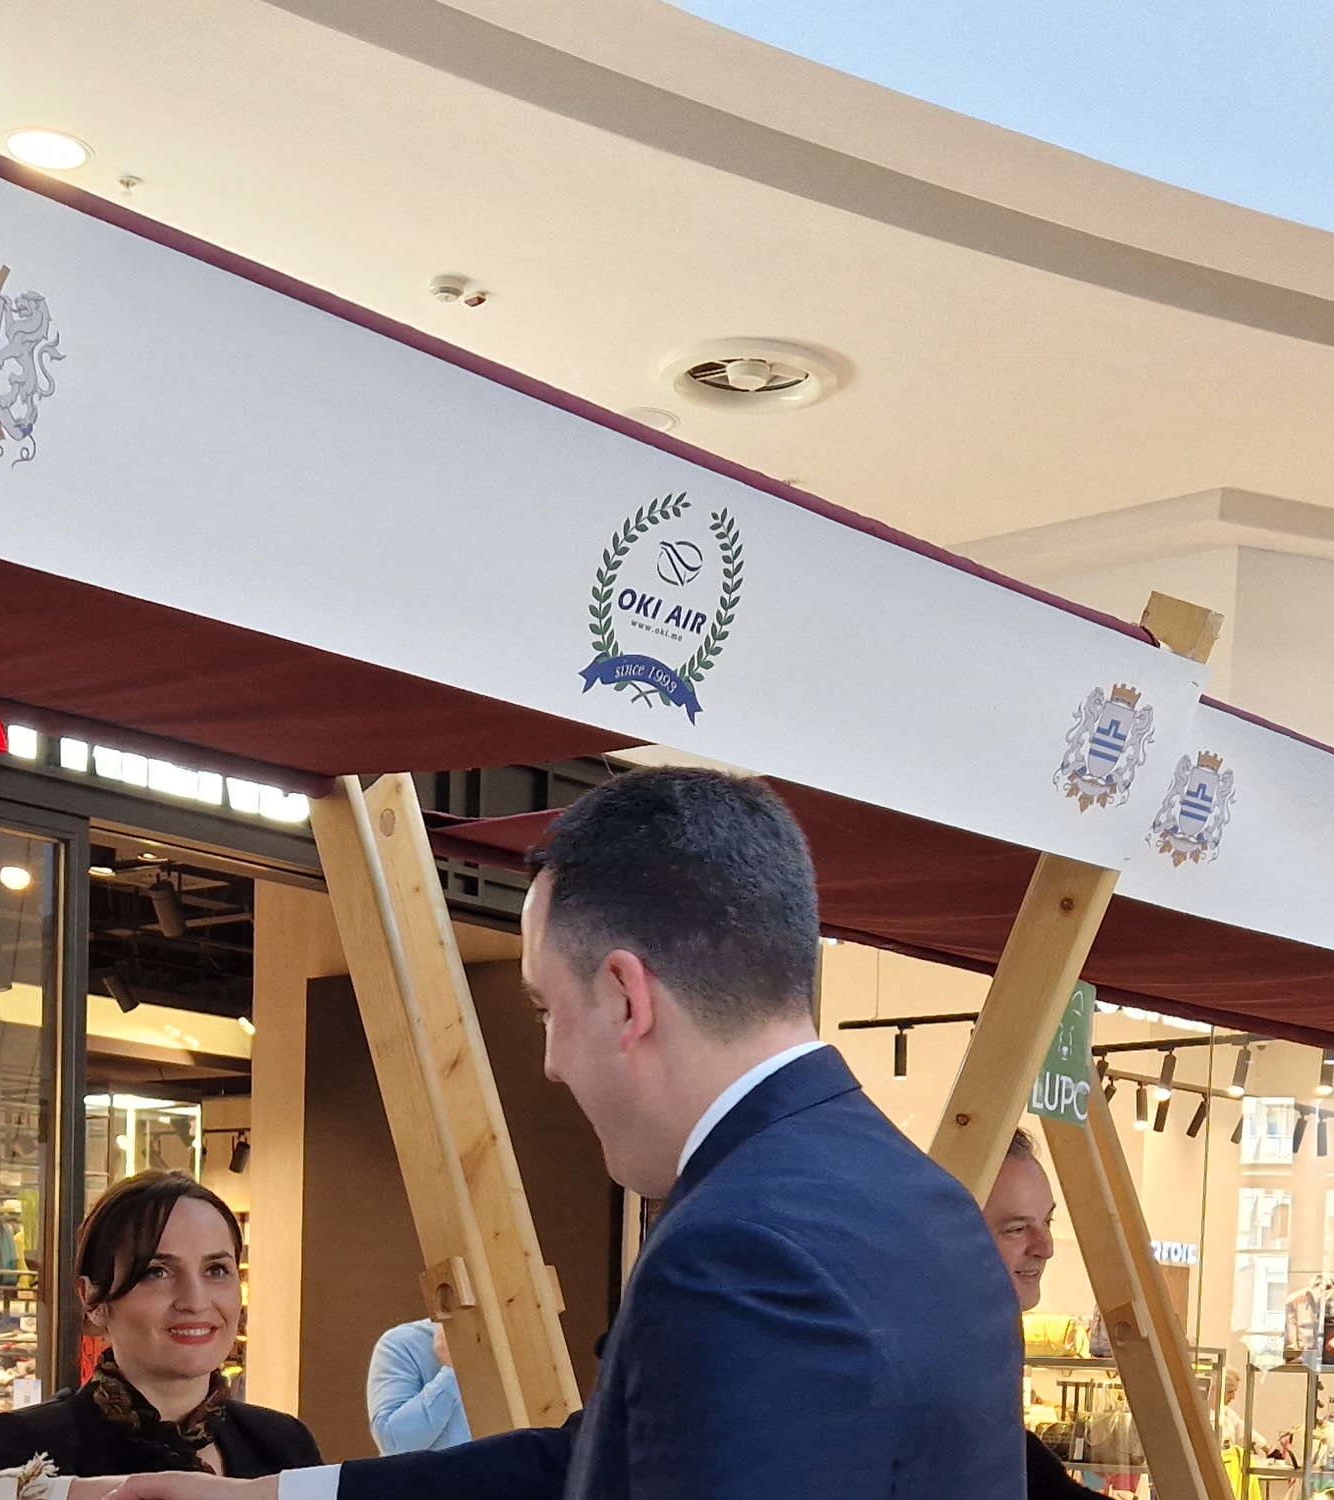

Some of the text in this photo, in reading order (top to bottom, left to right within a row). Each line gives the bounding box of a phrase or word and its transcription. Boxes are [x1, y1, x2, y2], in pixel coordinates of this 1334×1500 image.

[617, 588, 708, 635] OKI AIR
[630, 618, 683, 642] www.oki.me
[614, 660, 645, 679] since
